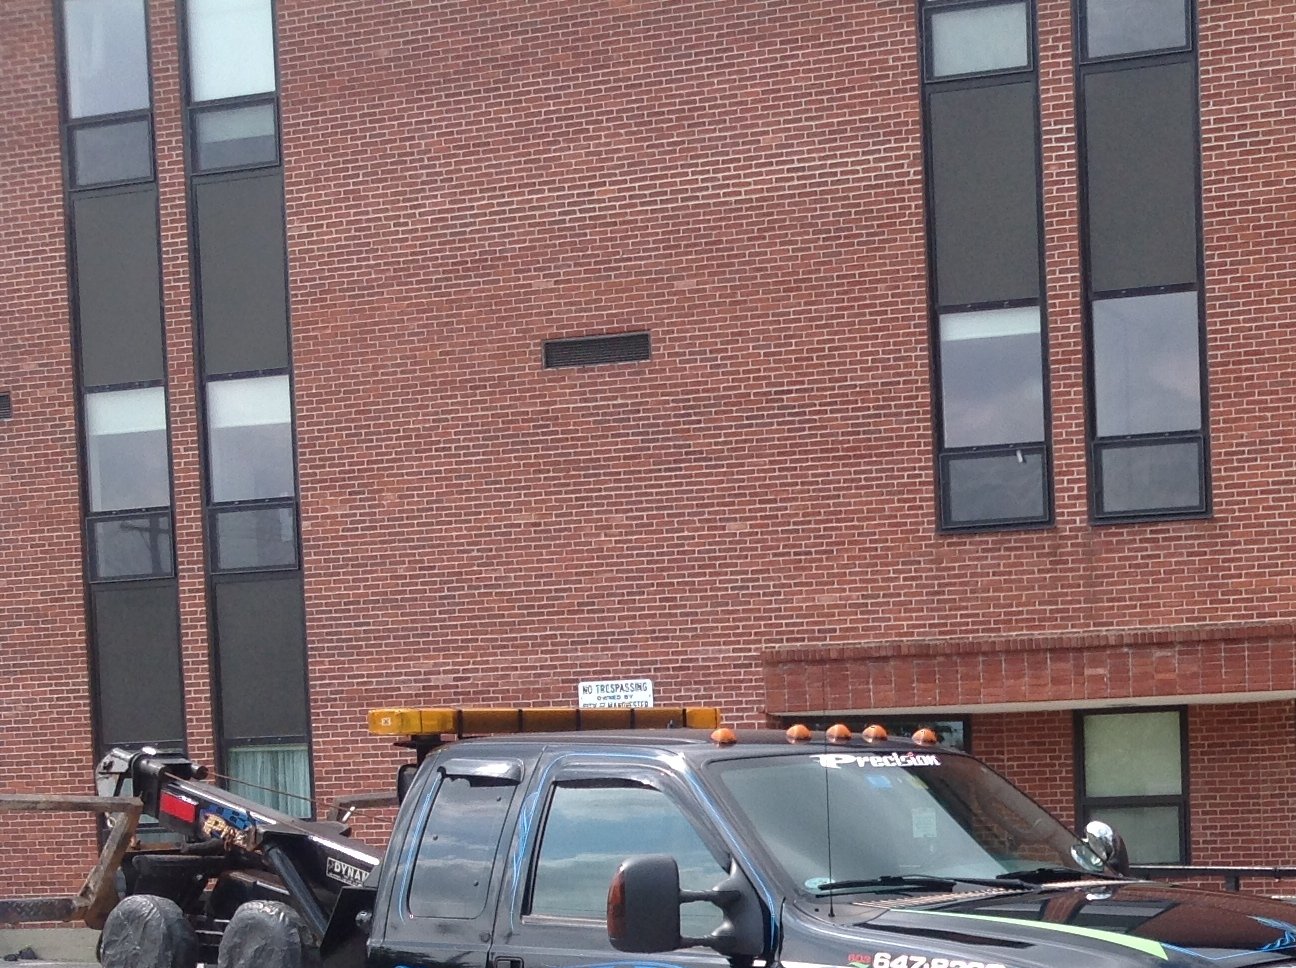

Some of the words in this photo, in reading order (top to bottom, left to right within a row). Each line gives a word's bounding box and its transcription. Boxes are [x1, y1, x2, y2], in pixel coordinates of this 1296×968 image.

[582, 685, 592, 694] NO
[596, 682, 648, 693] TRESPASSING
[809, 752, 942, 769] Precision
